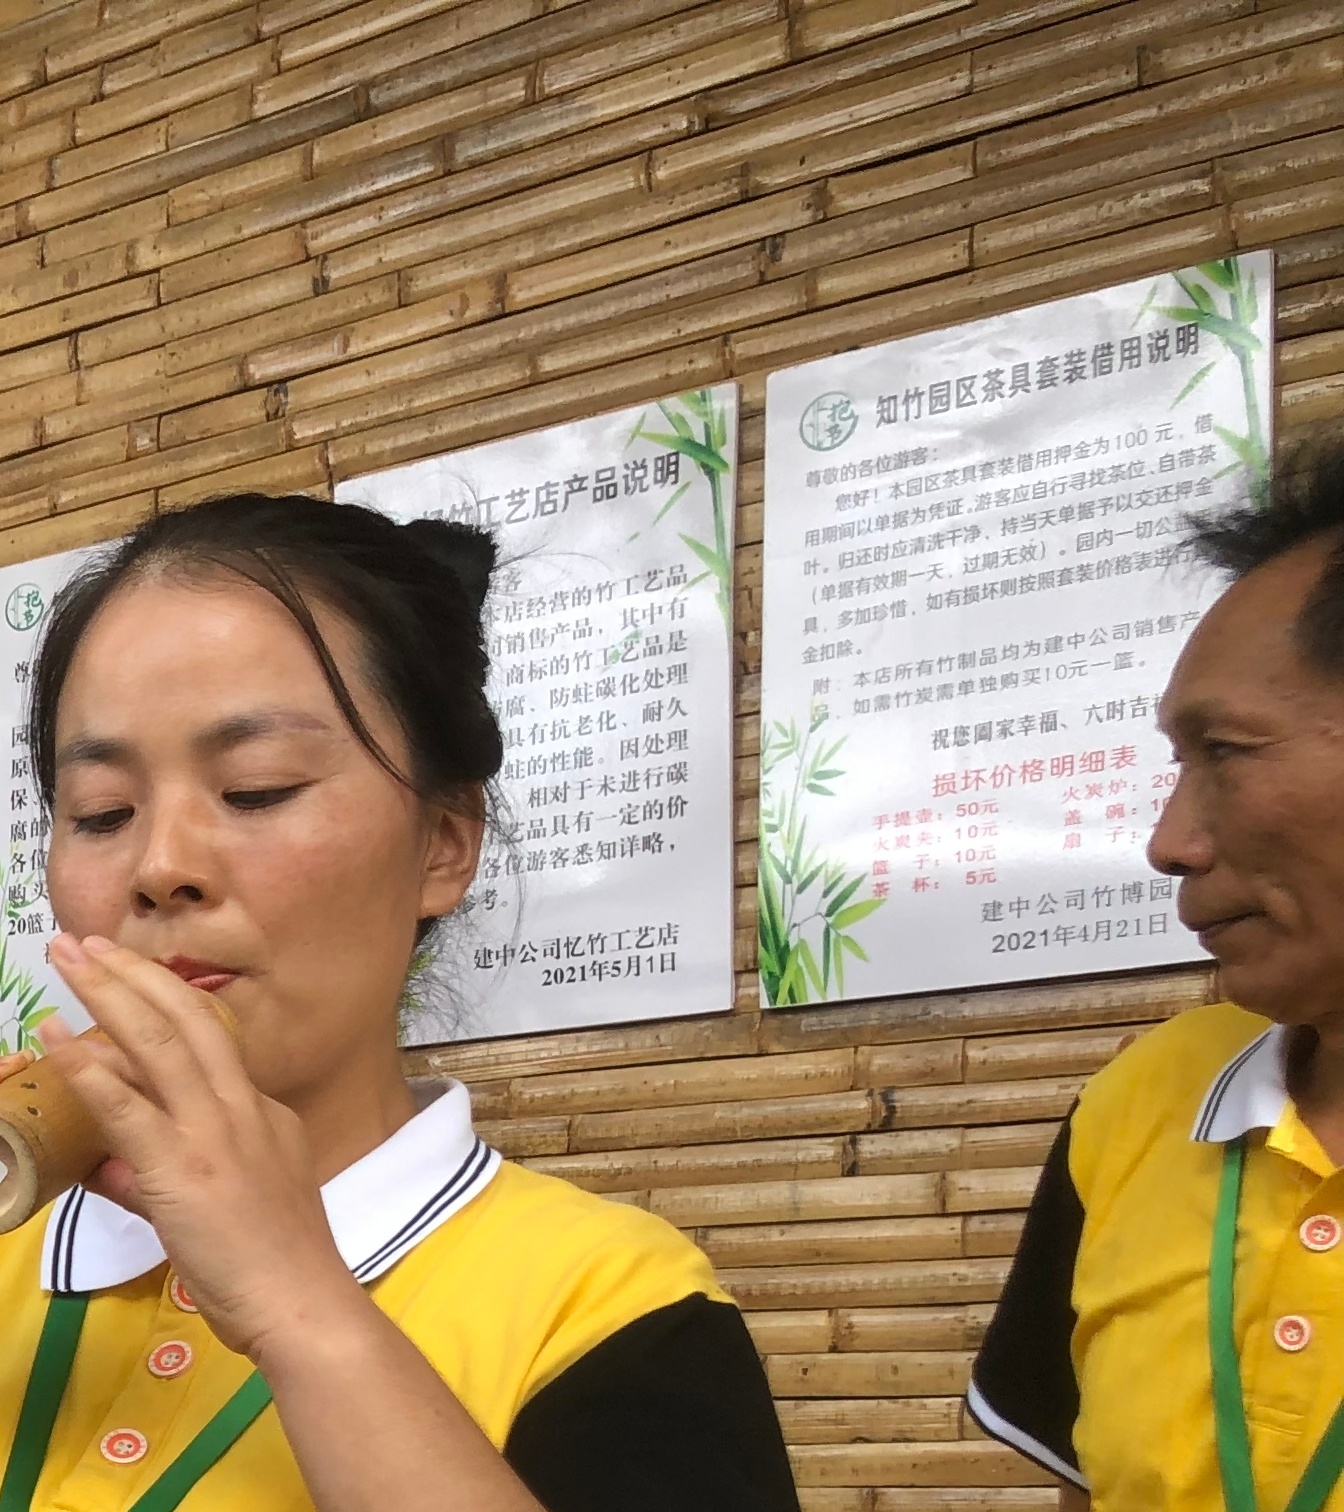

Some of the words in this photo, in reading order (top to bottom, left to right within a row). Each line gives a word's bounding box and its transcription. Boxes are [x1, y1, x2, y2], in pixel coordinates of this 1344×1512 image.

[875, 323, 1201, 429] 知竹园区茶具套装借用说明
[801, 639, 862, 665] 金扣除。
[931, 744, 1137, 798] 损坏价格明细表
[980, 877, 1173, 924] 建中公司竹博园
[473, 922, 680, 971] 建中公司忆竹工艺店
[992, 912, 1169, 955] 2021年4月21日
[541, 951, 677, 987] 2021年5月1日
